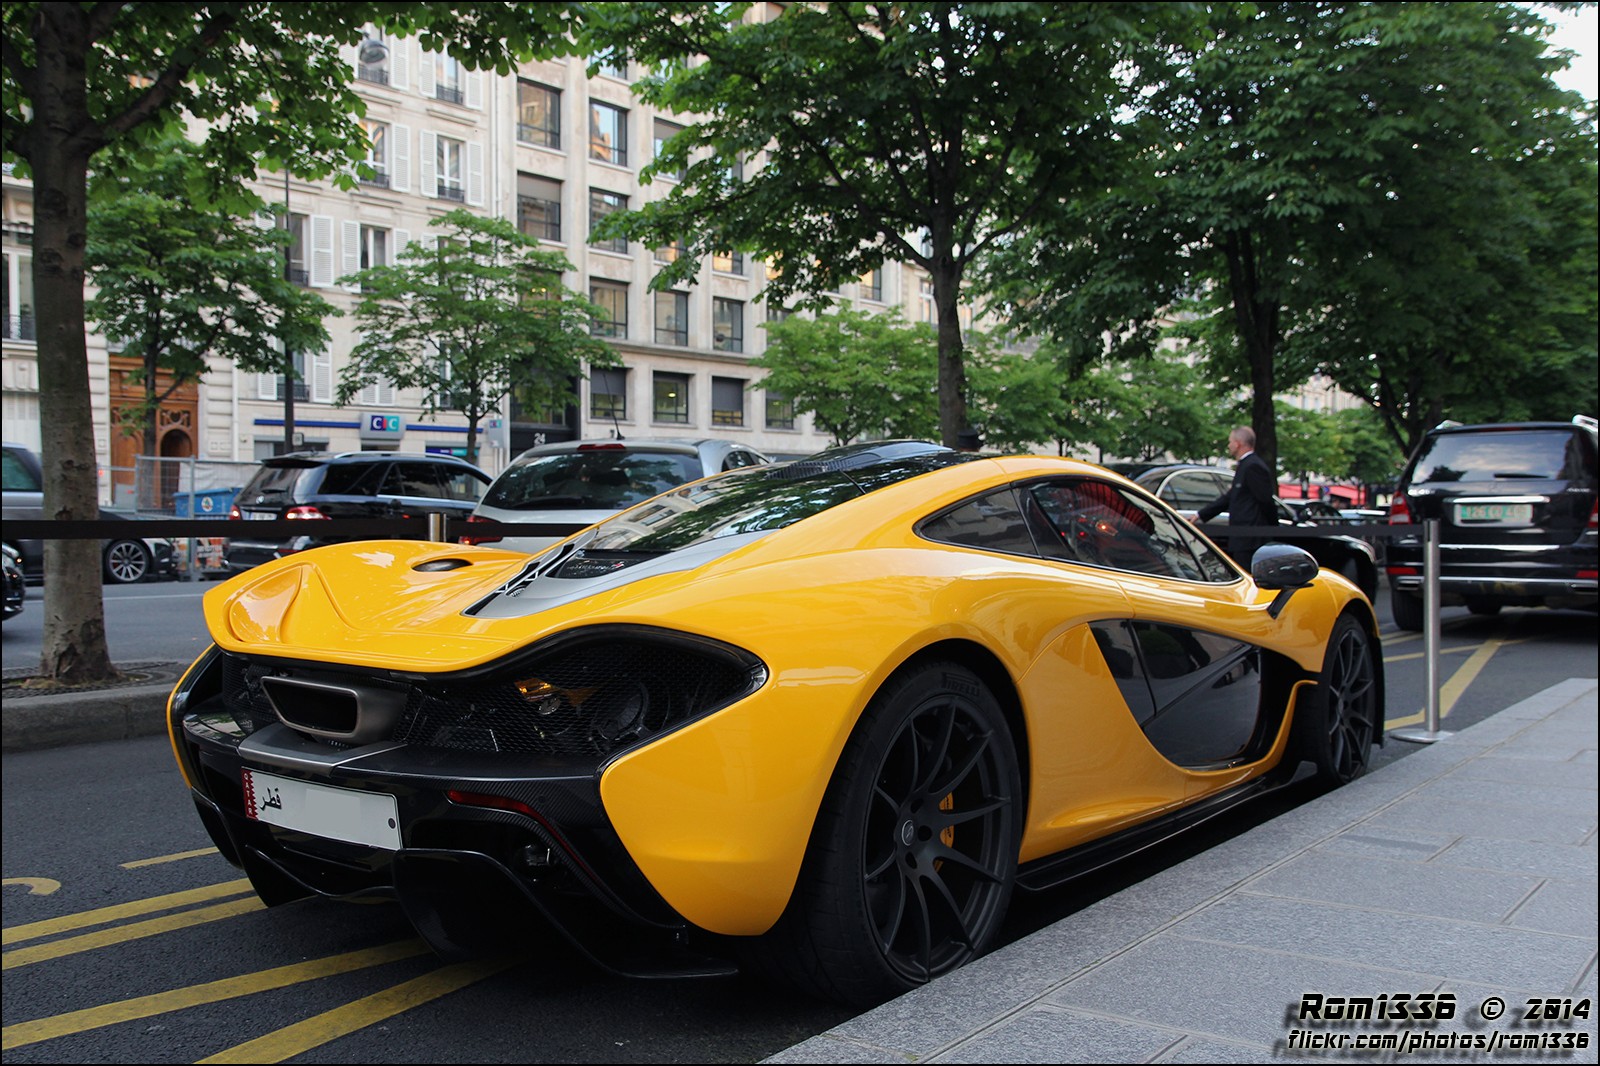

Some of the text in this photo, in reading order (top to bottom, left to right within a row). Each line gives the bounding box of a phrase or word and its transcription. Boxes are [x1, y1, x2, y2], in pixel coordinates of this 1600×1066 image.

[372, 416, 398, 431] CIC
[534, 432, 546, 446] 24
[941, 672, 981, 697] PIRELLI
[243, 772, 253, 815] QATAR
[259, 787, 282, 811] قطر
